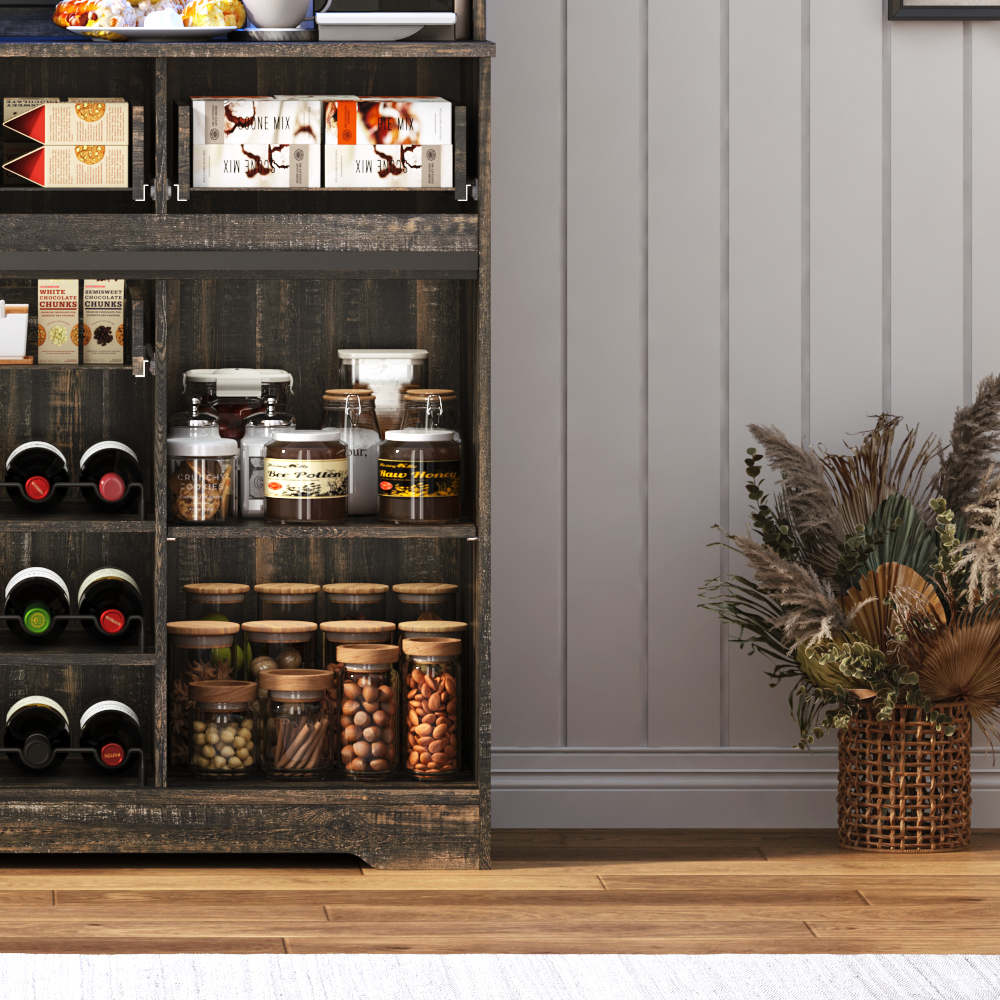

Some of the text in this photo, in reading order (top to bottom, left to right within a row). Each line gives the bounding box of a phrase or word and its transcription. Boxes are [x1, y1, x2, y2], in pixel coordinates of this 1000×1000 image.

[274, 116, 290, 130] MIX
[378, 118, 414, 130] PIE MIX
[294, 470, 341, 478] Pollen
[412, 470, 456, 479] Honey
